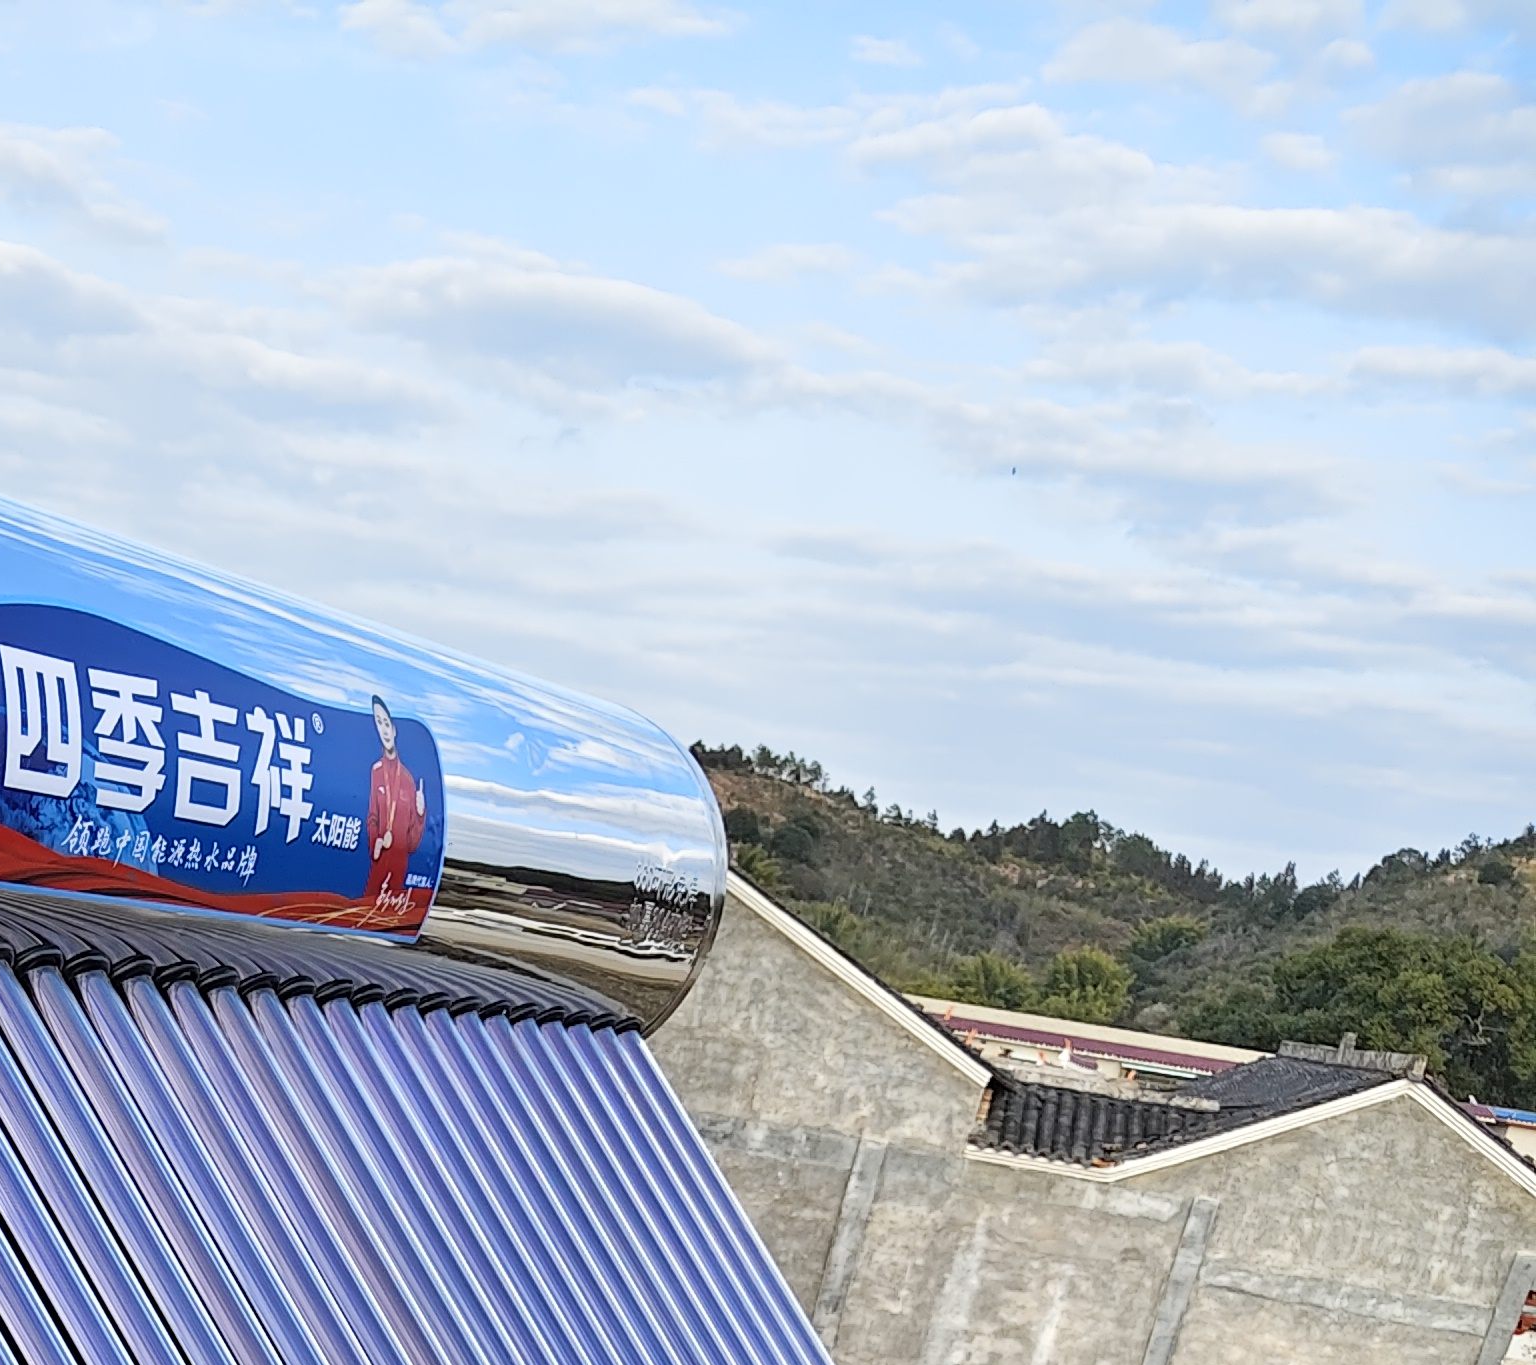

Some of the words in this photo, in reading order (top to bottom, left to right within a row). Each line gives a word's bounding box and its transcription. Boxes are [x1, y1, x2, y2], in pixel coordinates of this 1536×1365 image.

[61, 814, 258, 887] 领跑中国能源热水品牌
[312, 810, 361, 851] 太阳能
